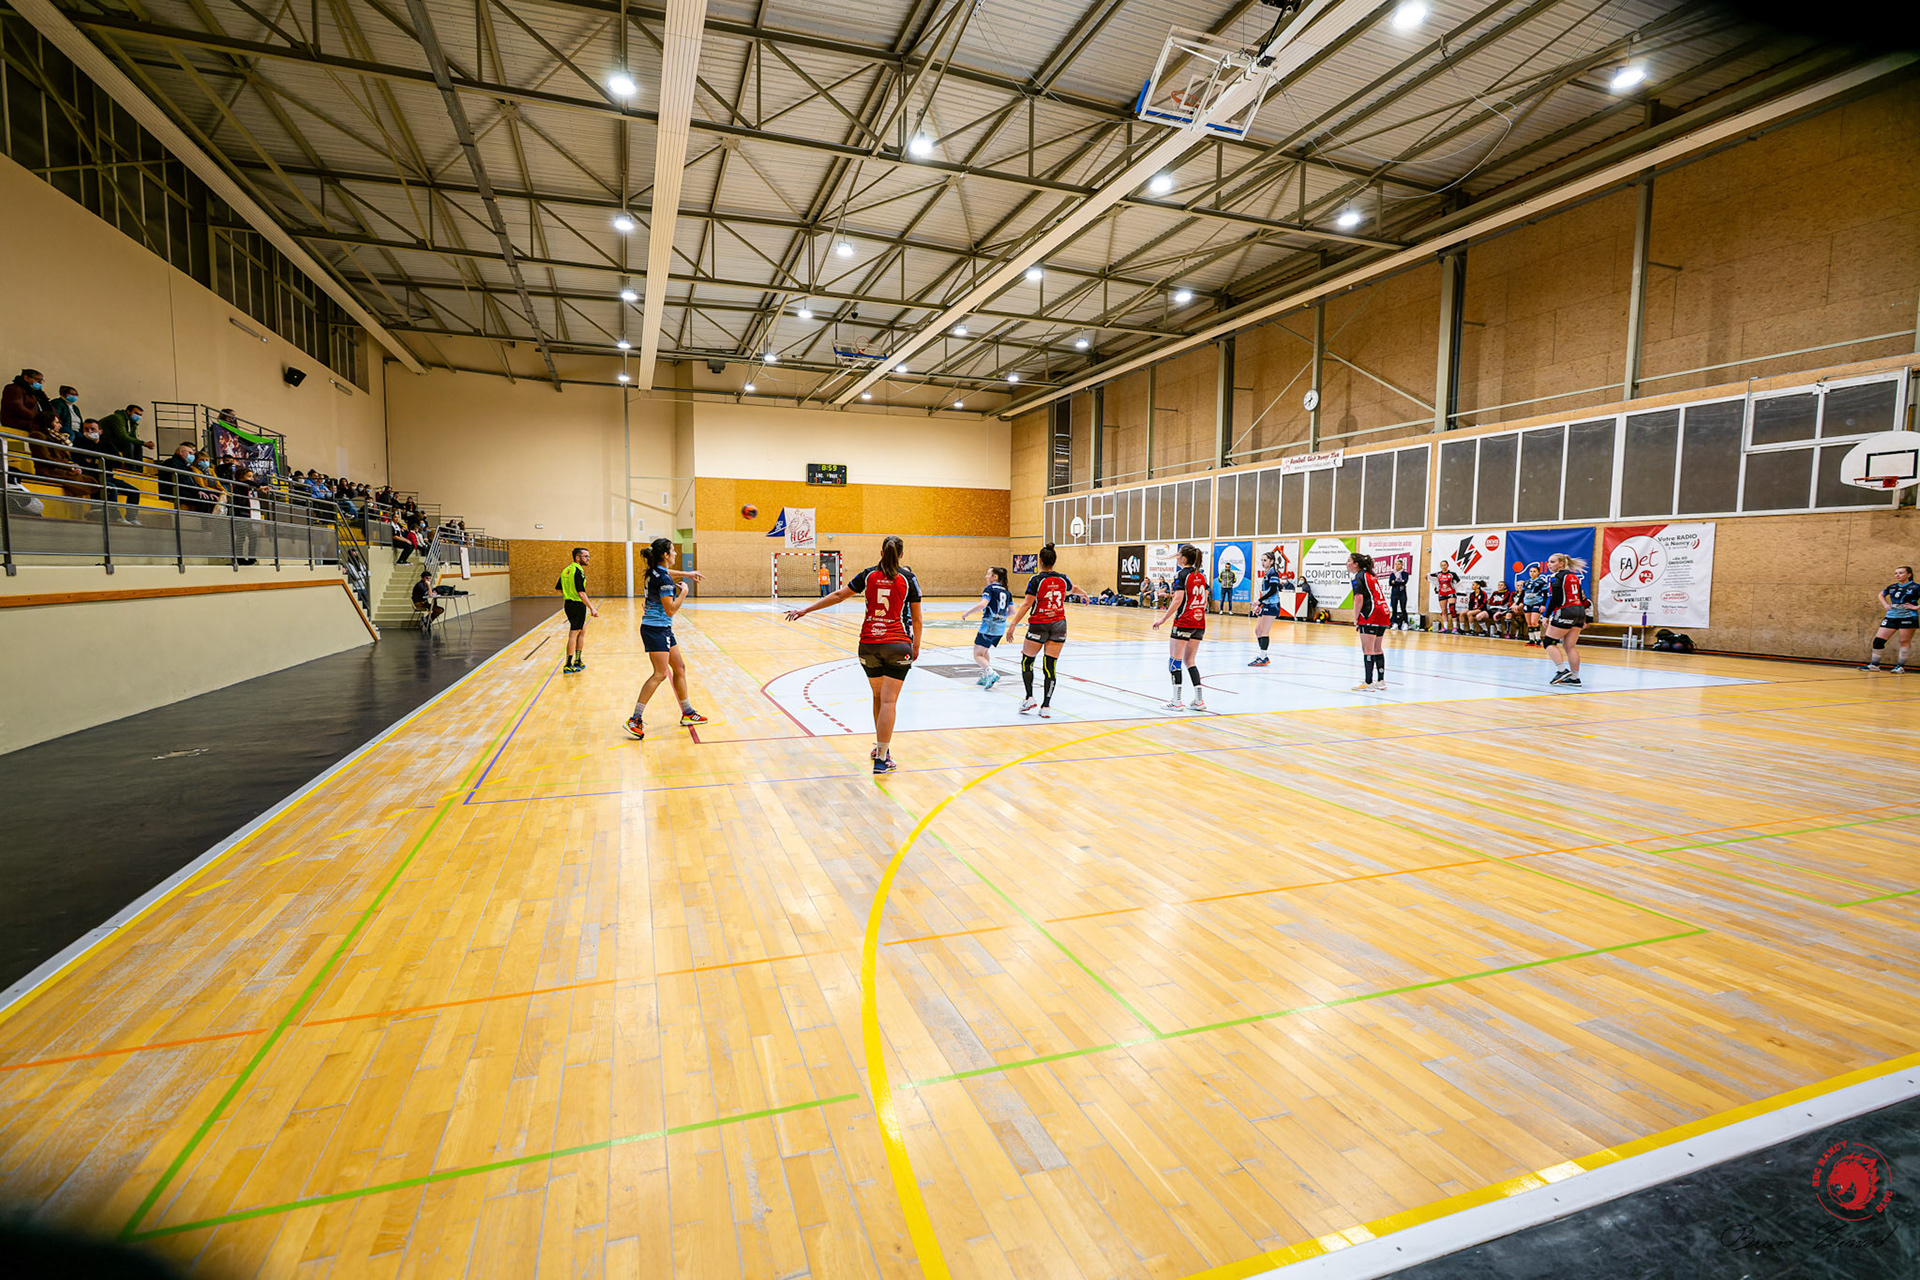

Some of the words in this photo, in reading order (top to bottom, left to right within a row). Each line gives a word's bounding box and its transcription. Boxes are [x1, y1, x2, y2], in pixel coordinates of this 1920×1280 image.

[1305, 569, 1350, 579] COMPTOIR
[877, 588, 891, 611] 5
[999, 592, 1007, 610] 8
